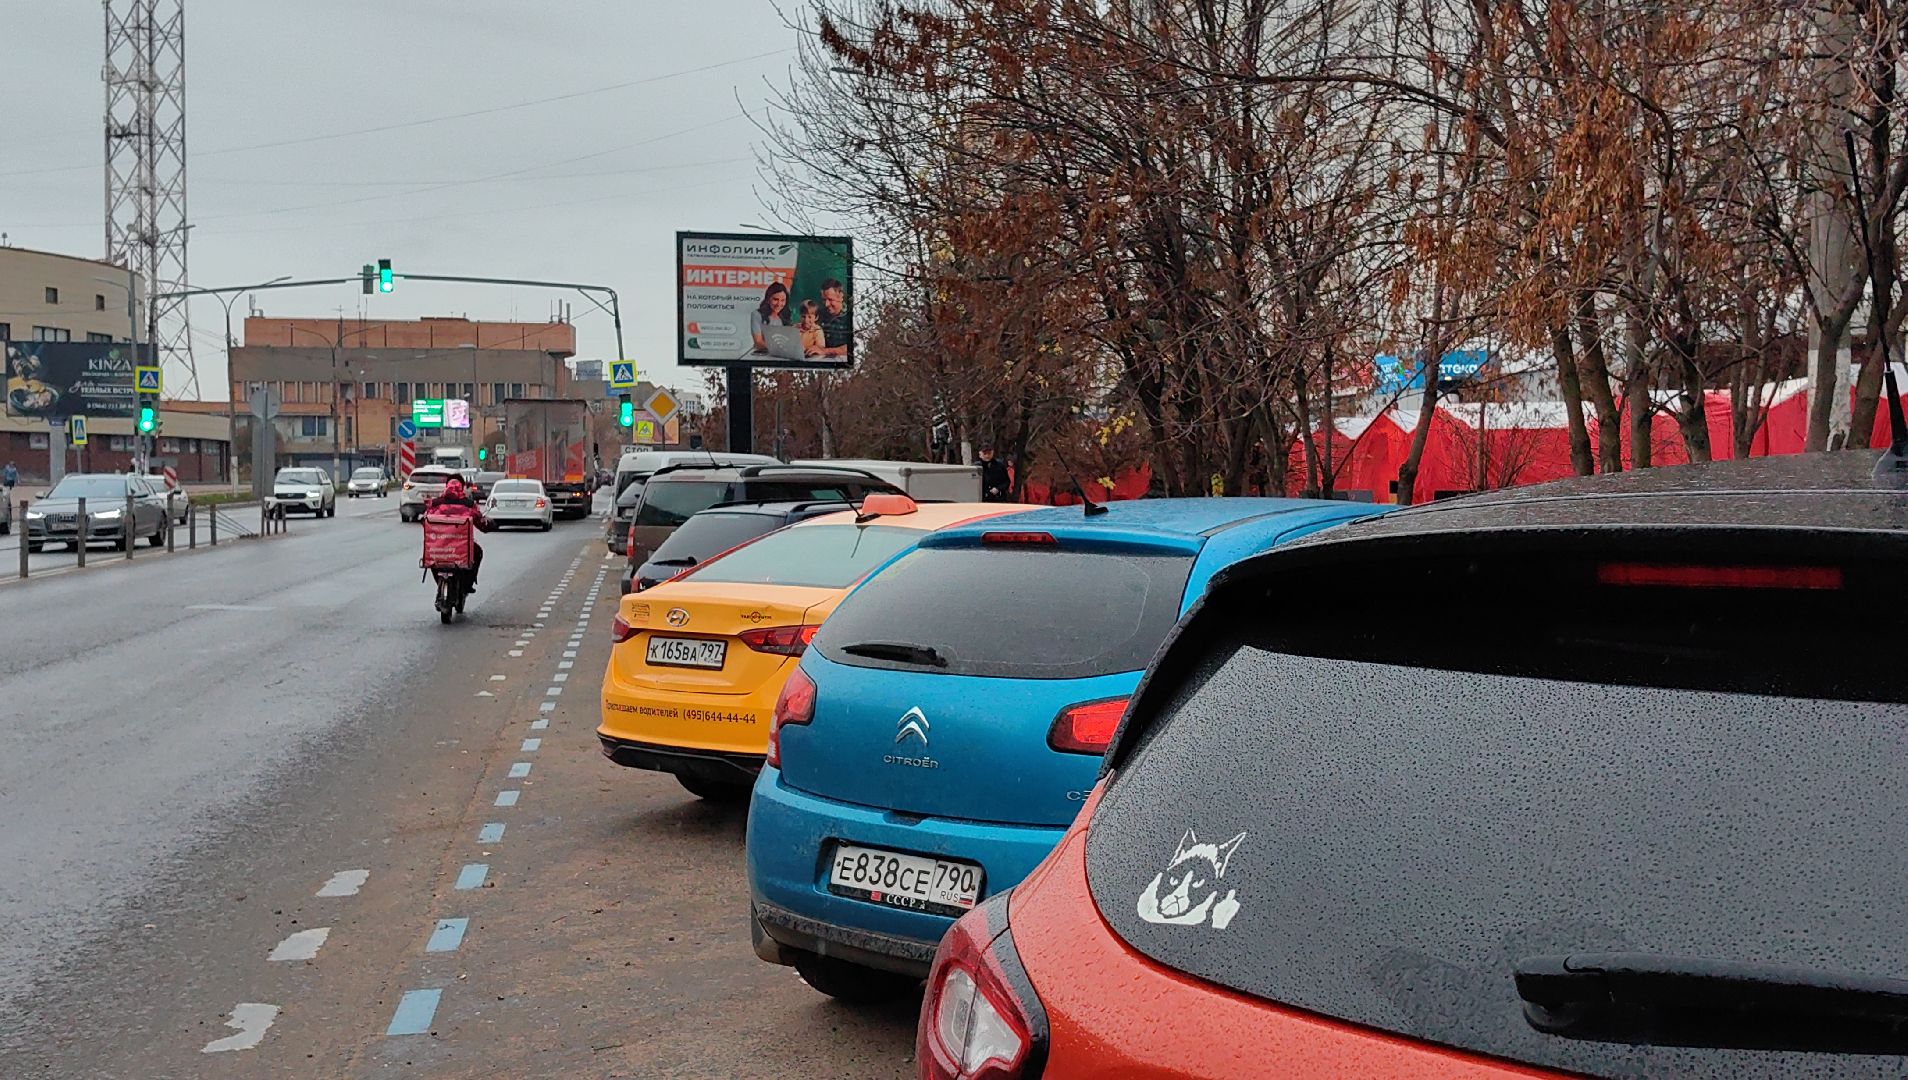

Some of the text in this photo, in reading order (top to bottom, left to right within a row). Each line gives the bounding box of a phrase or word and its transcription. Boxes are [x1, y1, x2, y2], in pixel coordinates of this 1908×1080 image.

[686, 244, 775, 255] ИНФОЛИНК
[686, 269, 786, 285] ИНТЕРНЕТ
[88, 359, 132, 370] KINZA
[1439, 364, 1478, 374] птека
[700, 643, 722, 659] 797
[639, 705, 679, 718] водителей
[683, 709, 756, 724] (495)644-44-44
[935, 864, 974, 893] 790
[886, 894, 917, 908] СССР
[939, 890, 959, 903] RUS
